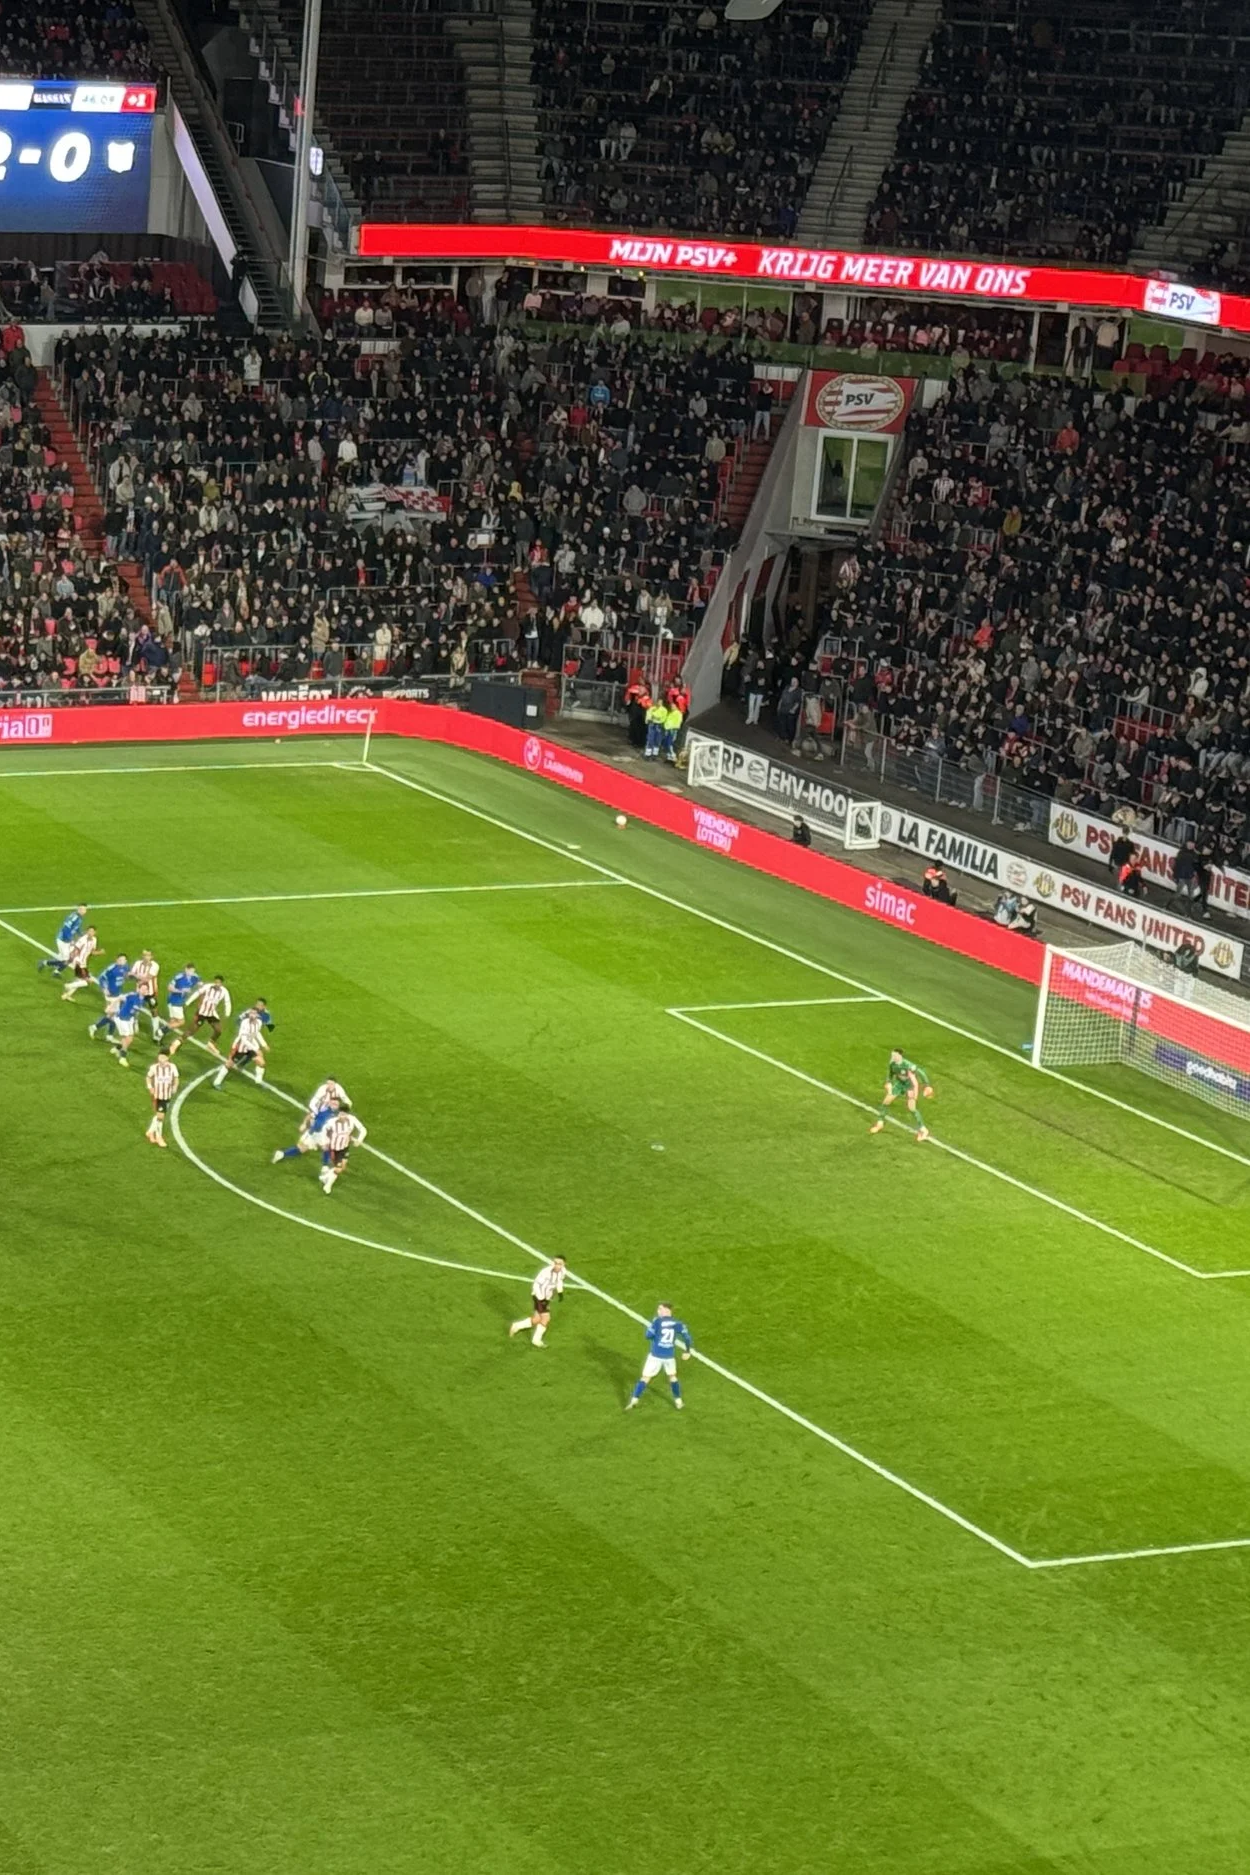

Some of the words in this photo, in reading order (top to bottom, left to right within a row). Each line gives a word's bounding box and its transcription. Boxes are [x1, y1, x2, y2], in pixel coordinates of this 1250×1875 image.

[609, 239, 676, 264] MIJN
[676, 244, 738, 269] PSV+
[758, 248, 837, 279] KRIJG
[839, 255, 914, 287] MEER
[919, 262, 974, 290] VAN
[974, 267, 1032, 296] ONS
[1170, 292, 1196, 310] PSV
[845, 393, 875, 406] PSV
[243, 706, 378, 730] energiedirect
[897, 816, 920, 848] LA
[924, 827, 999, 880] FAMILIA
[1085, 824, 1114, 855] PS
[864, 881, 917, 926] simac
[1060, 883, 1092, 912] PSV
[1094, 896, 1137, 930] FANS
[1141, 914, 1206, 957] UNITED
